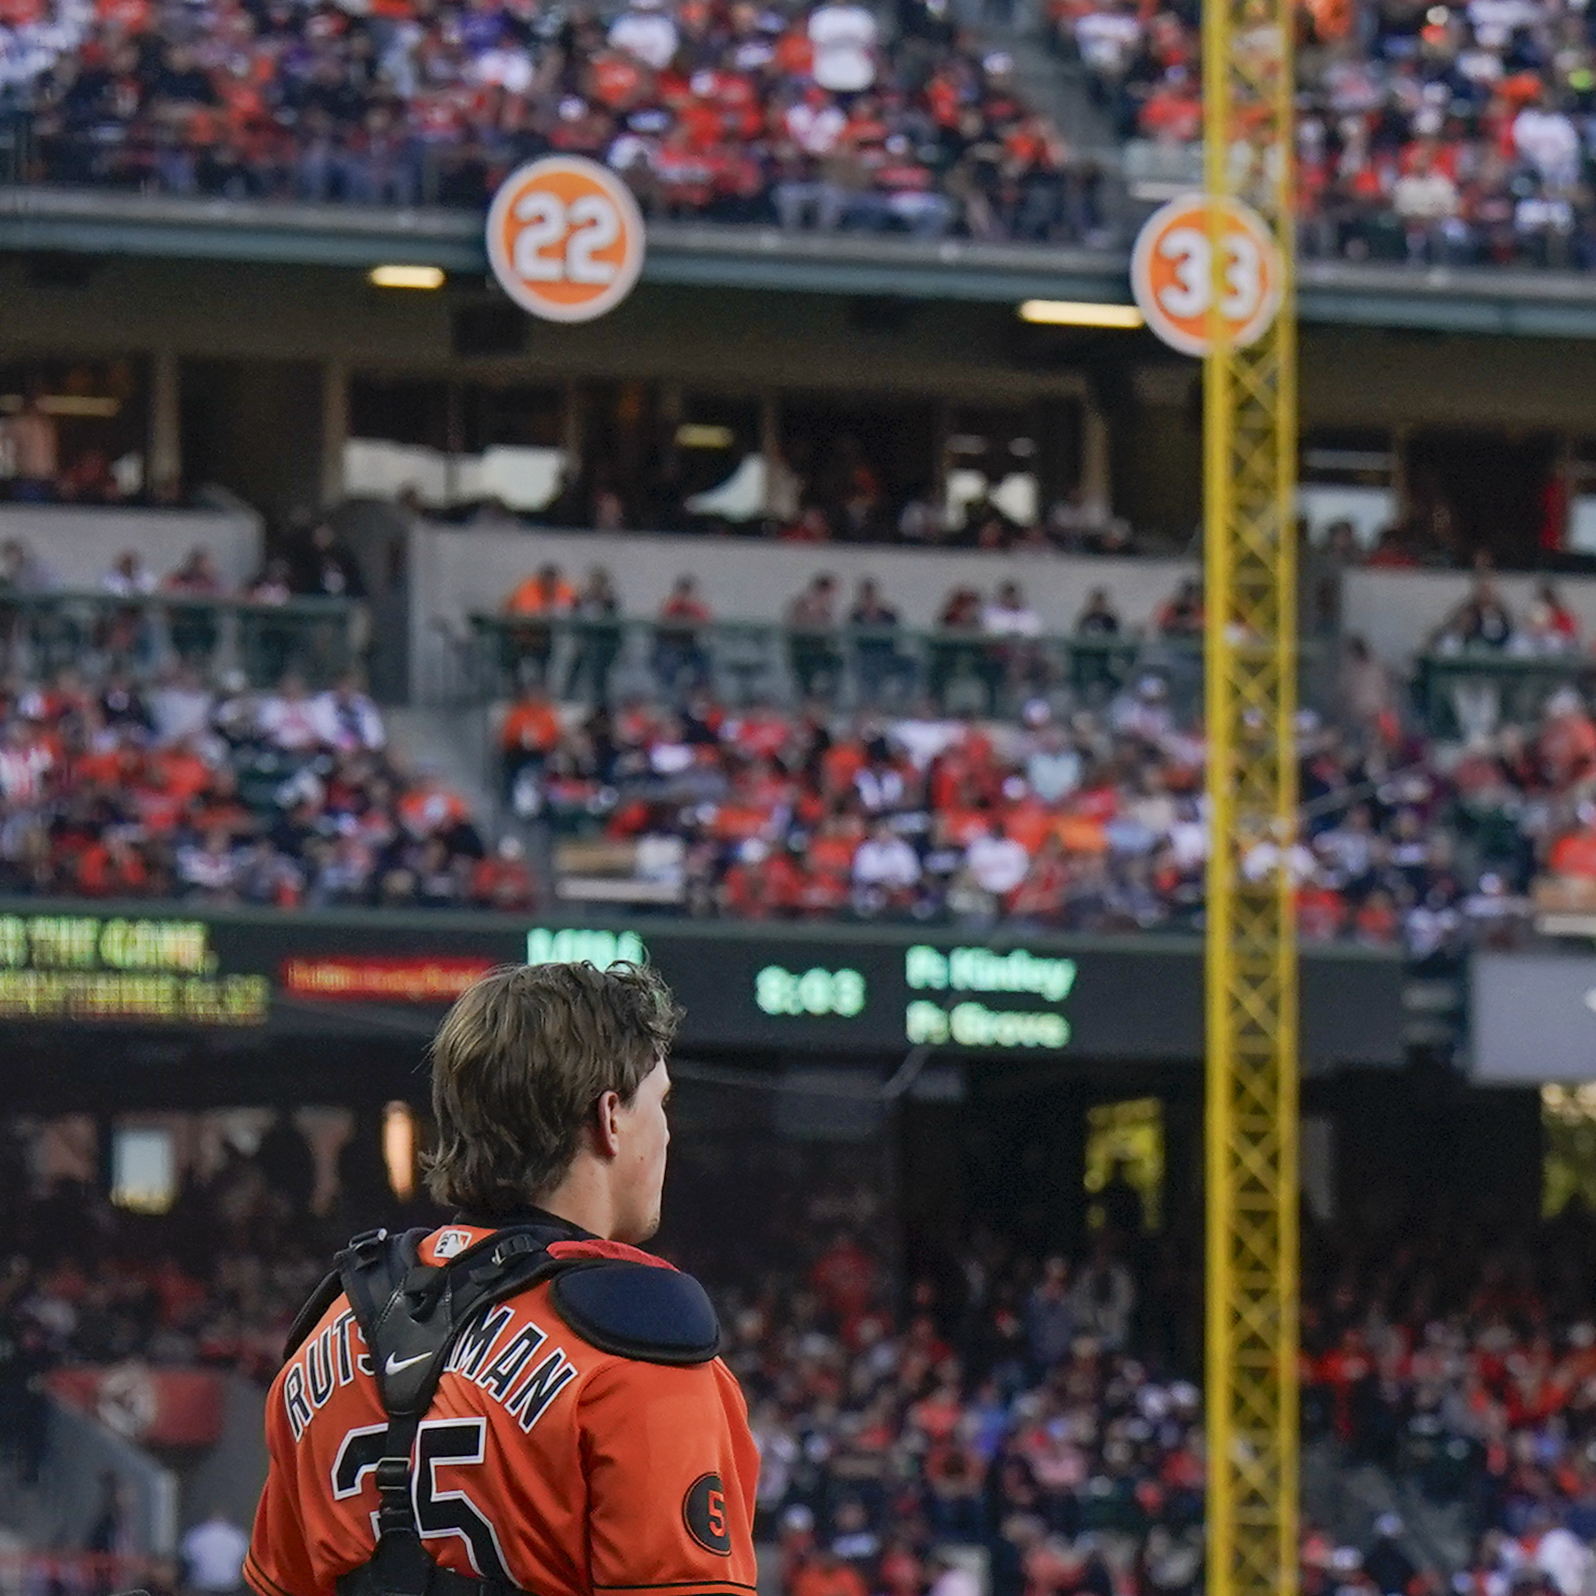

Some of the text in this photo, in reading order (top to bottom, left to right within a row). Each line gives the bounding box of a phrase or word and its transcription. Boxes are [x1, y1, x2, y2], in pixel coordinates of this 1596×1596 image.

[515, 191, 620, 284] 22
[1158, 227, 1260, 319] 33
[708, 1487, 729, 1538] 5
